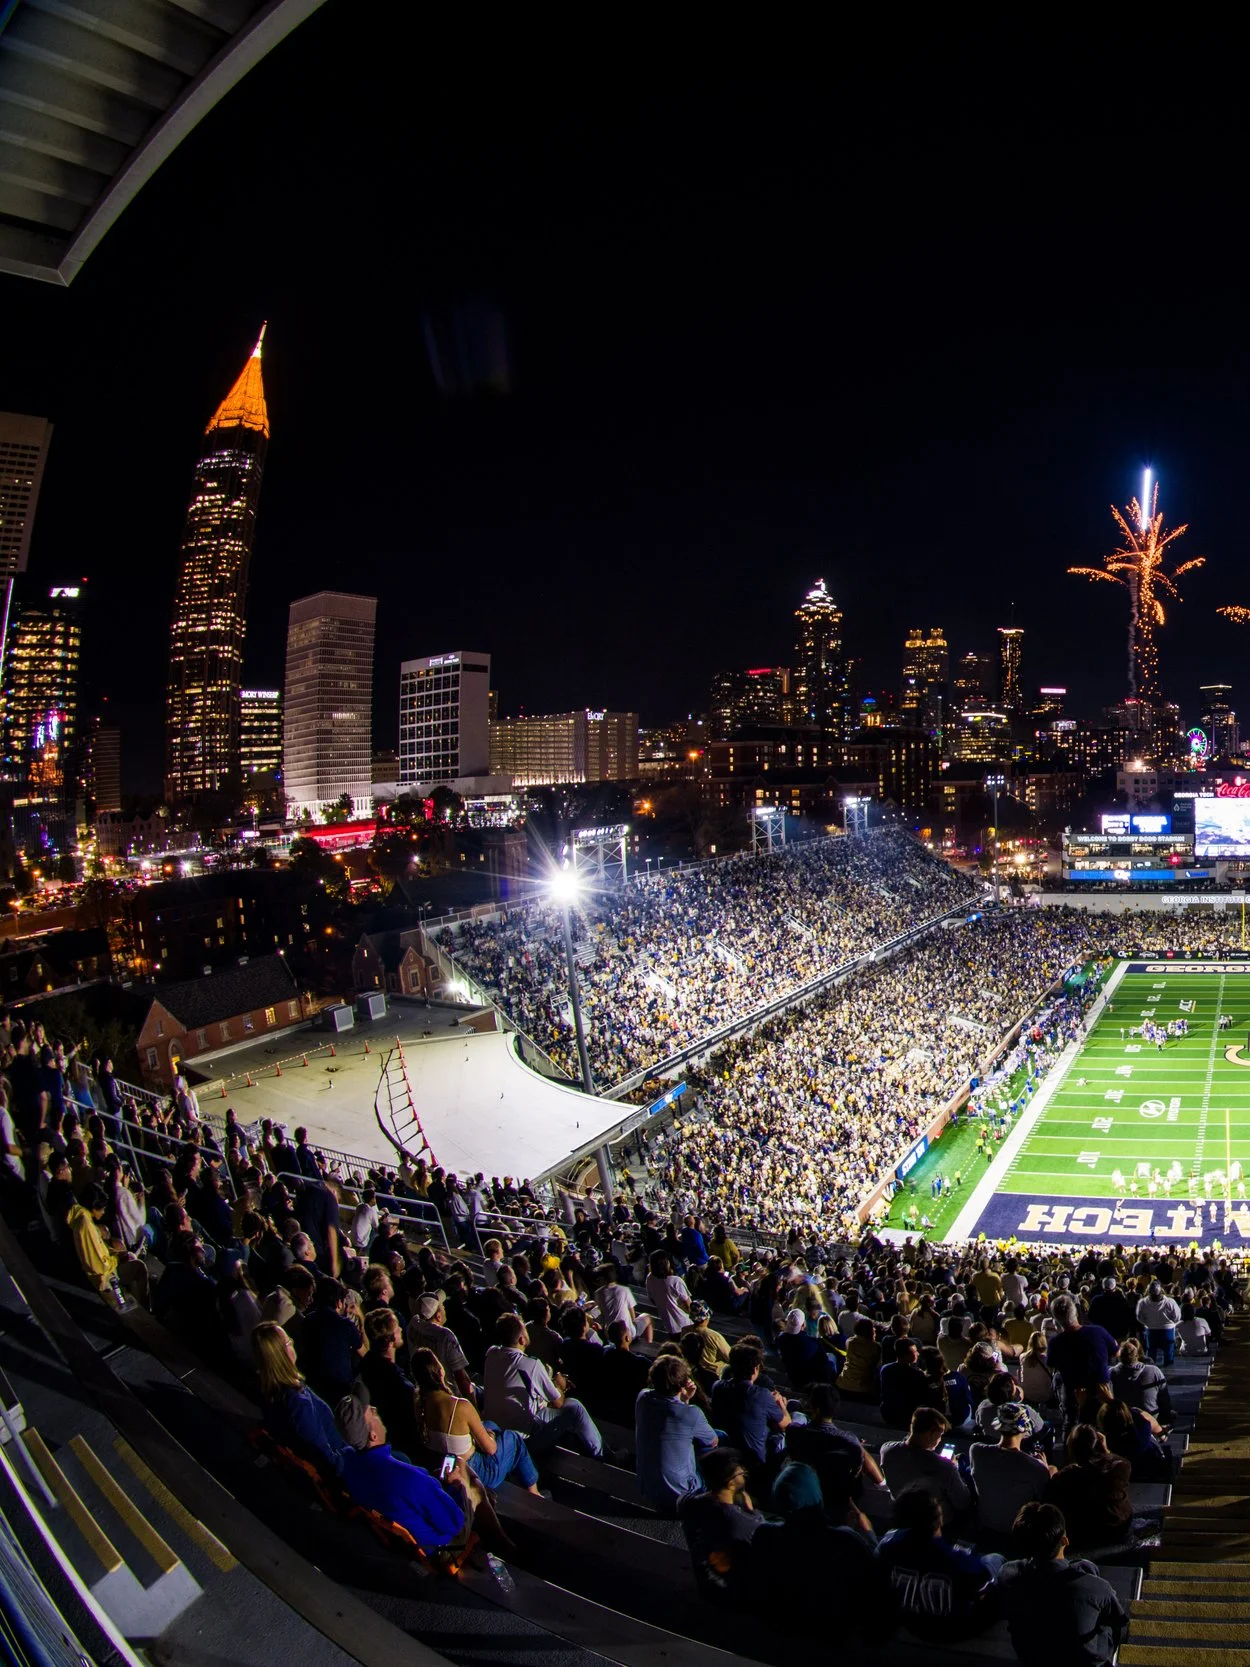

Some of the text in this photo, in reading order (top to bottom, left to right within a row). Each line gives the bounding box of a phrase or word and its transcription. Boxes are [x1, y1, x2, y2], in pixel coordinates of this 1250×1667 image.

[1161, 895, 1200, 904] GEORGIA
[1200, 895, 1245, 904] INSTITUTE
[1017, 1204, 1203, 1237] TECH
